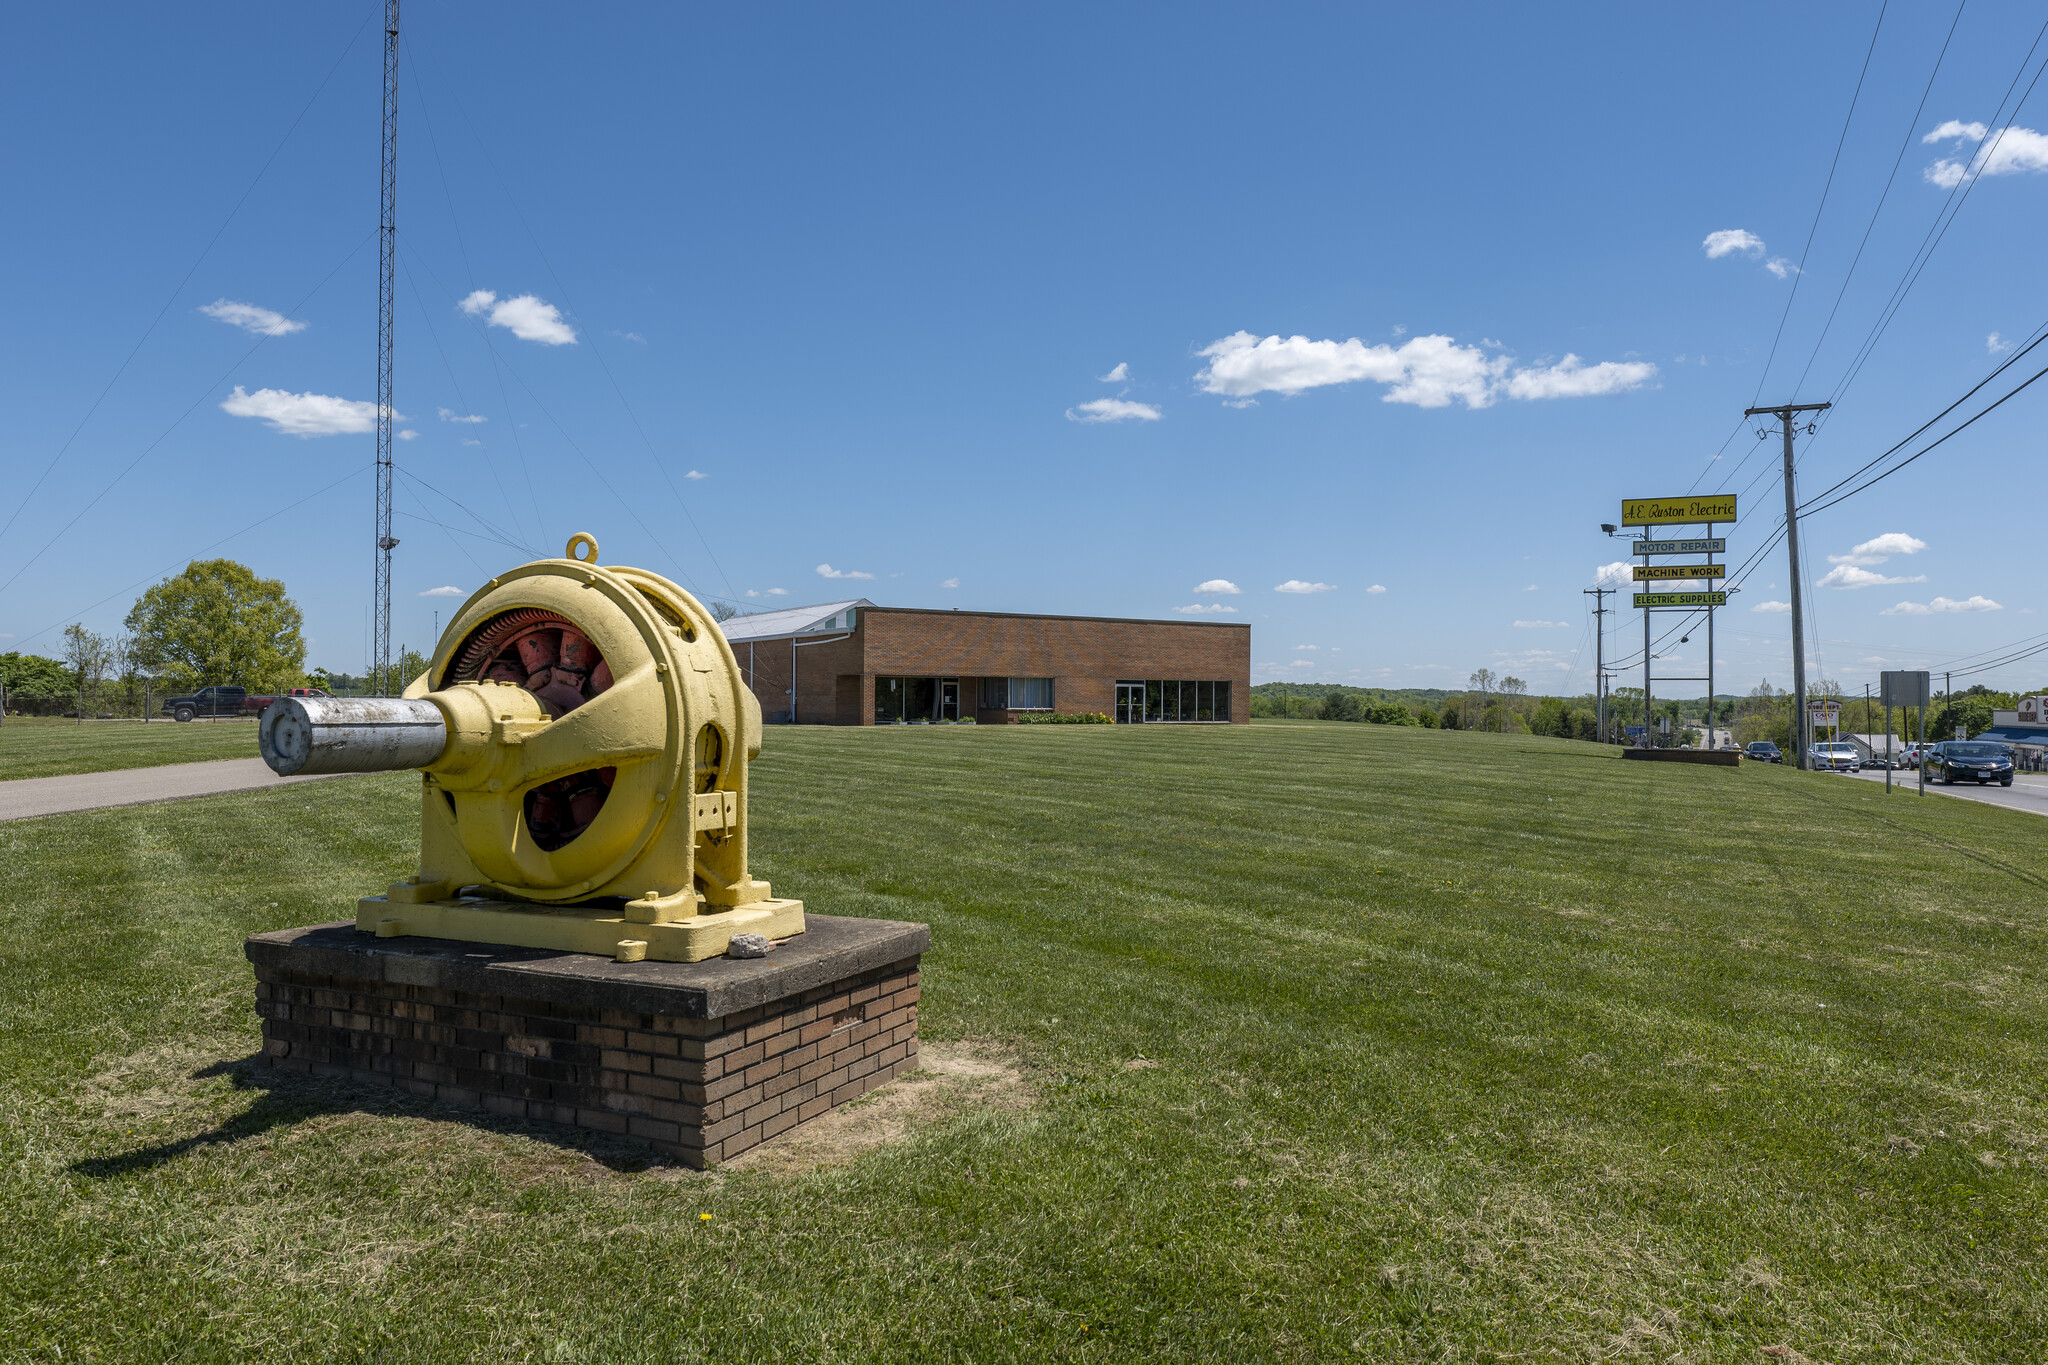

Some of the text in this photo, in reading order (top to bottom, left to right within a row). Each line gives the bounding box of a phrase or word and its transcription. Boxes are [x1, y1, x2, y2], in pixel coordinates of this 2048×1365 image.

[1648, 504, 1685, 519] Ruston
[1690, 502, 1734, 516] Electric
[1639, 541, 1720, 552] MOTOR REPAIR
[1638, 567, 1720, 577] MACHINE WORK
[1636, 594, 1724, 604] ELECTRIC SUPPLIES
